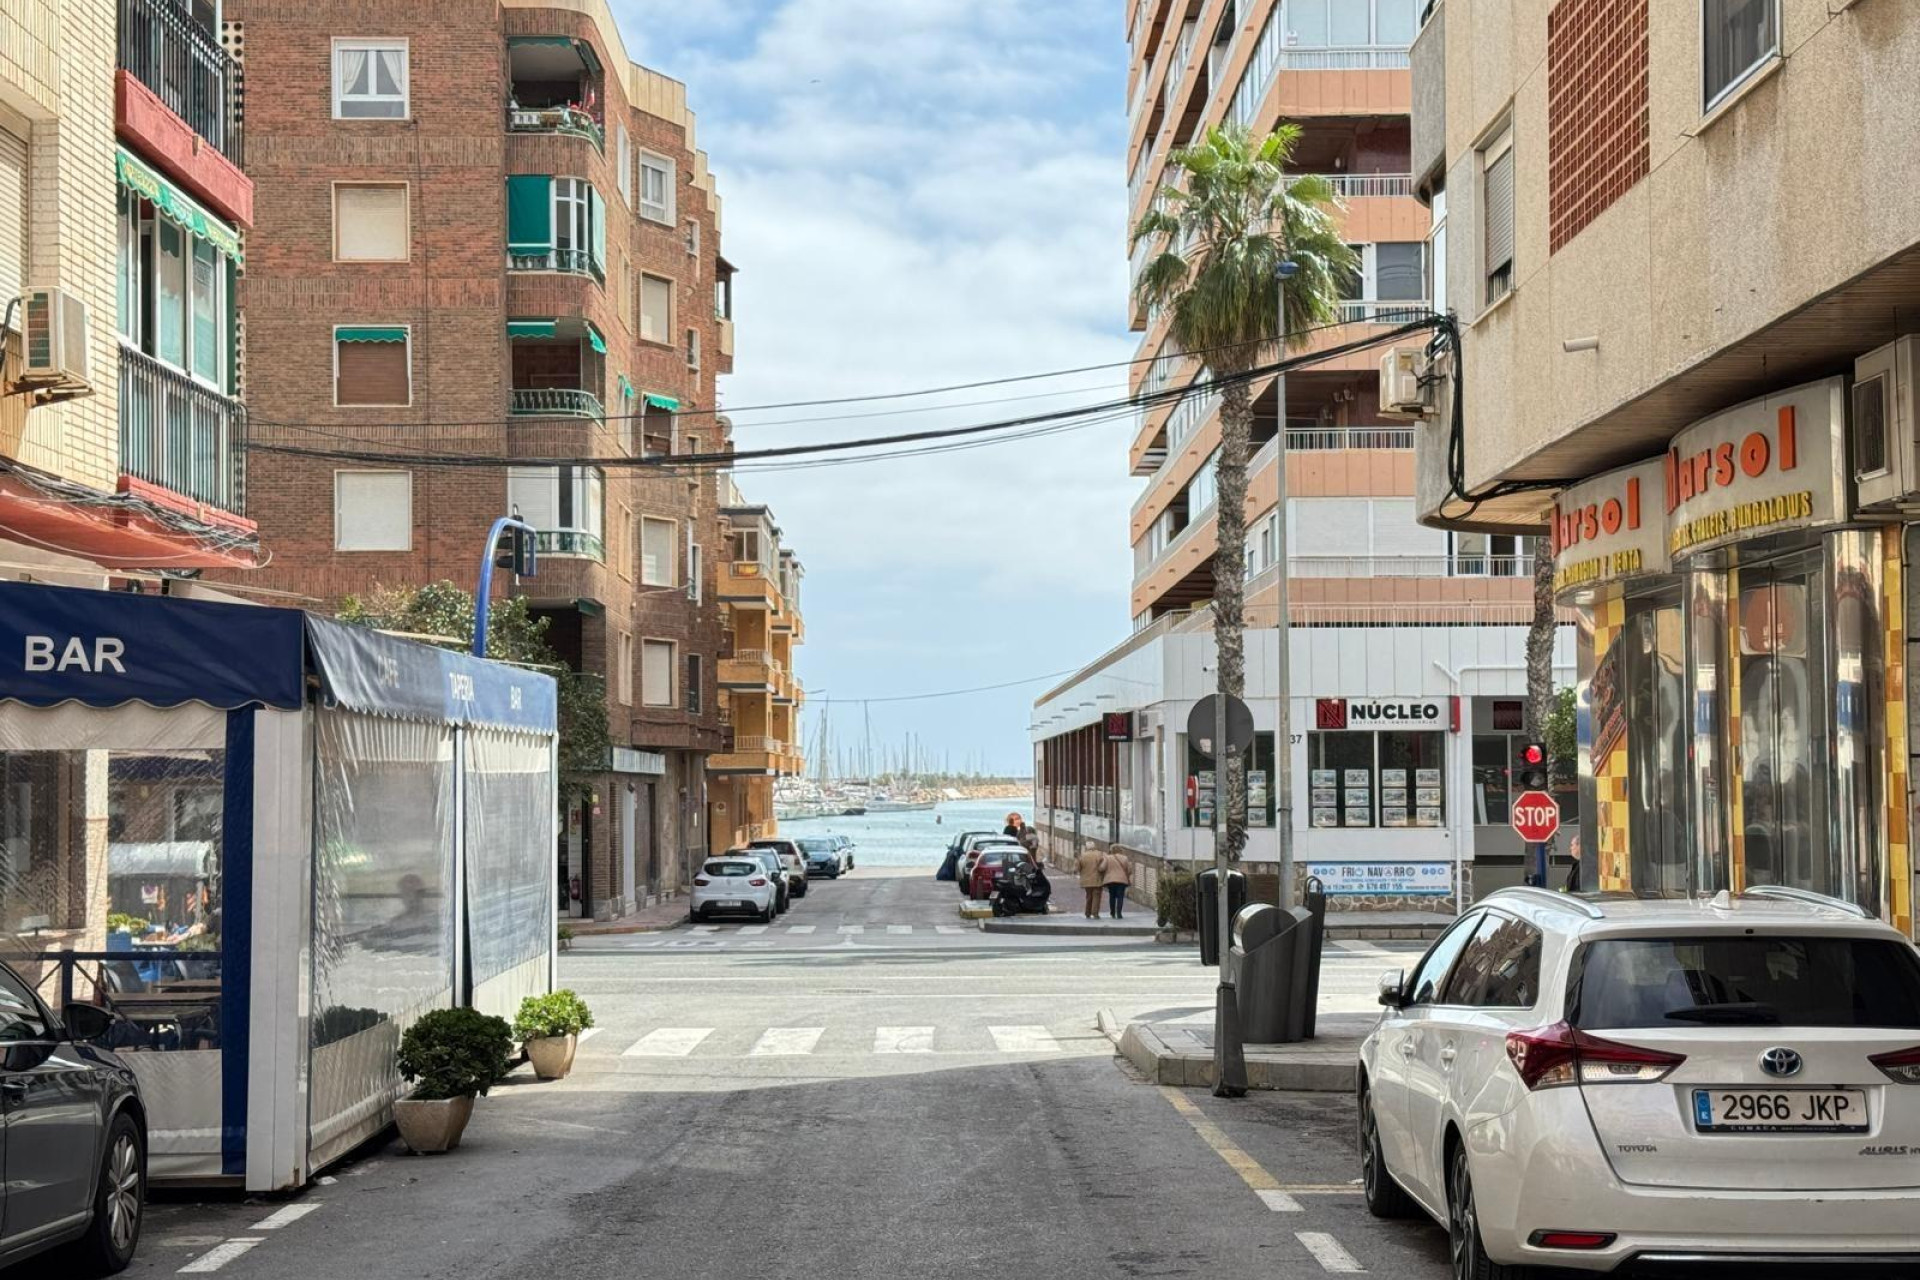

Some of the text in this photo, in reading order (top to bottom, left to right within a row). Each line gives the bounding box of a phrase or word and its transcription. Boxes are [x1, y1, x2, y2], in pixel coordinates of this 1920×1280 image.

[25, 635, 127, 673] BAR
[1351, 701, 1439, 720] NÚCLEO
[1290, 734, 1302, 744] 37
[1515, 806, 1556, 827] STOP
[1721, 1094, 1849, 1121] 2966 JKP
[1617, 1144, 1657, 1152] TOYOTA
